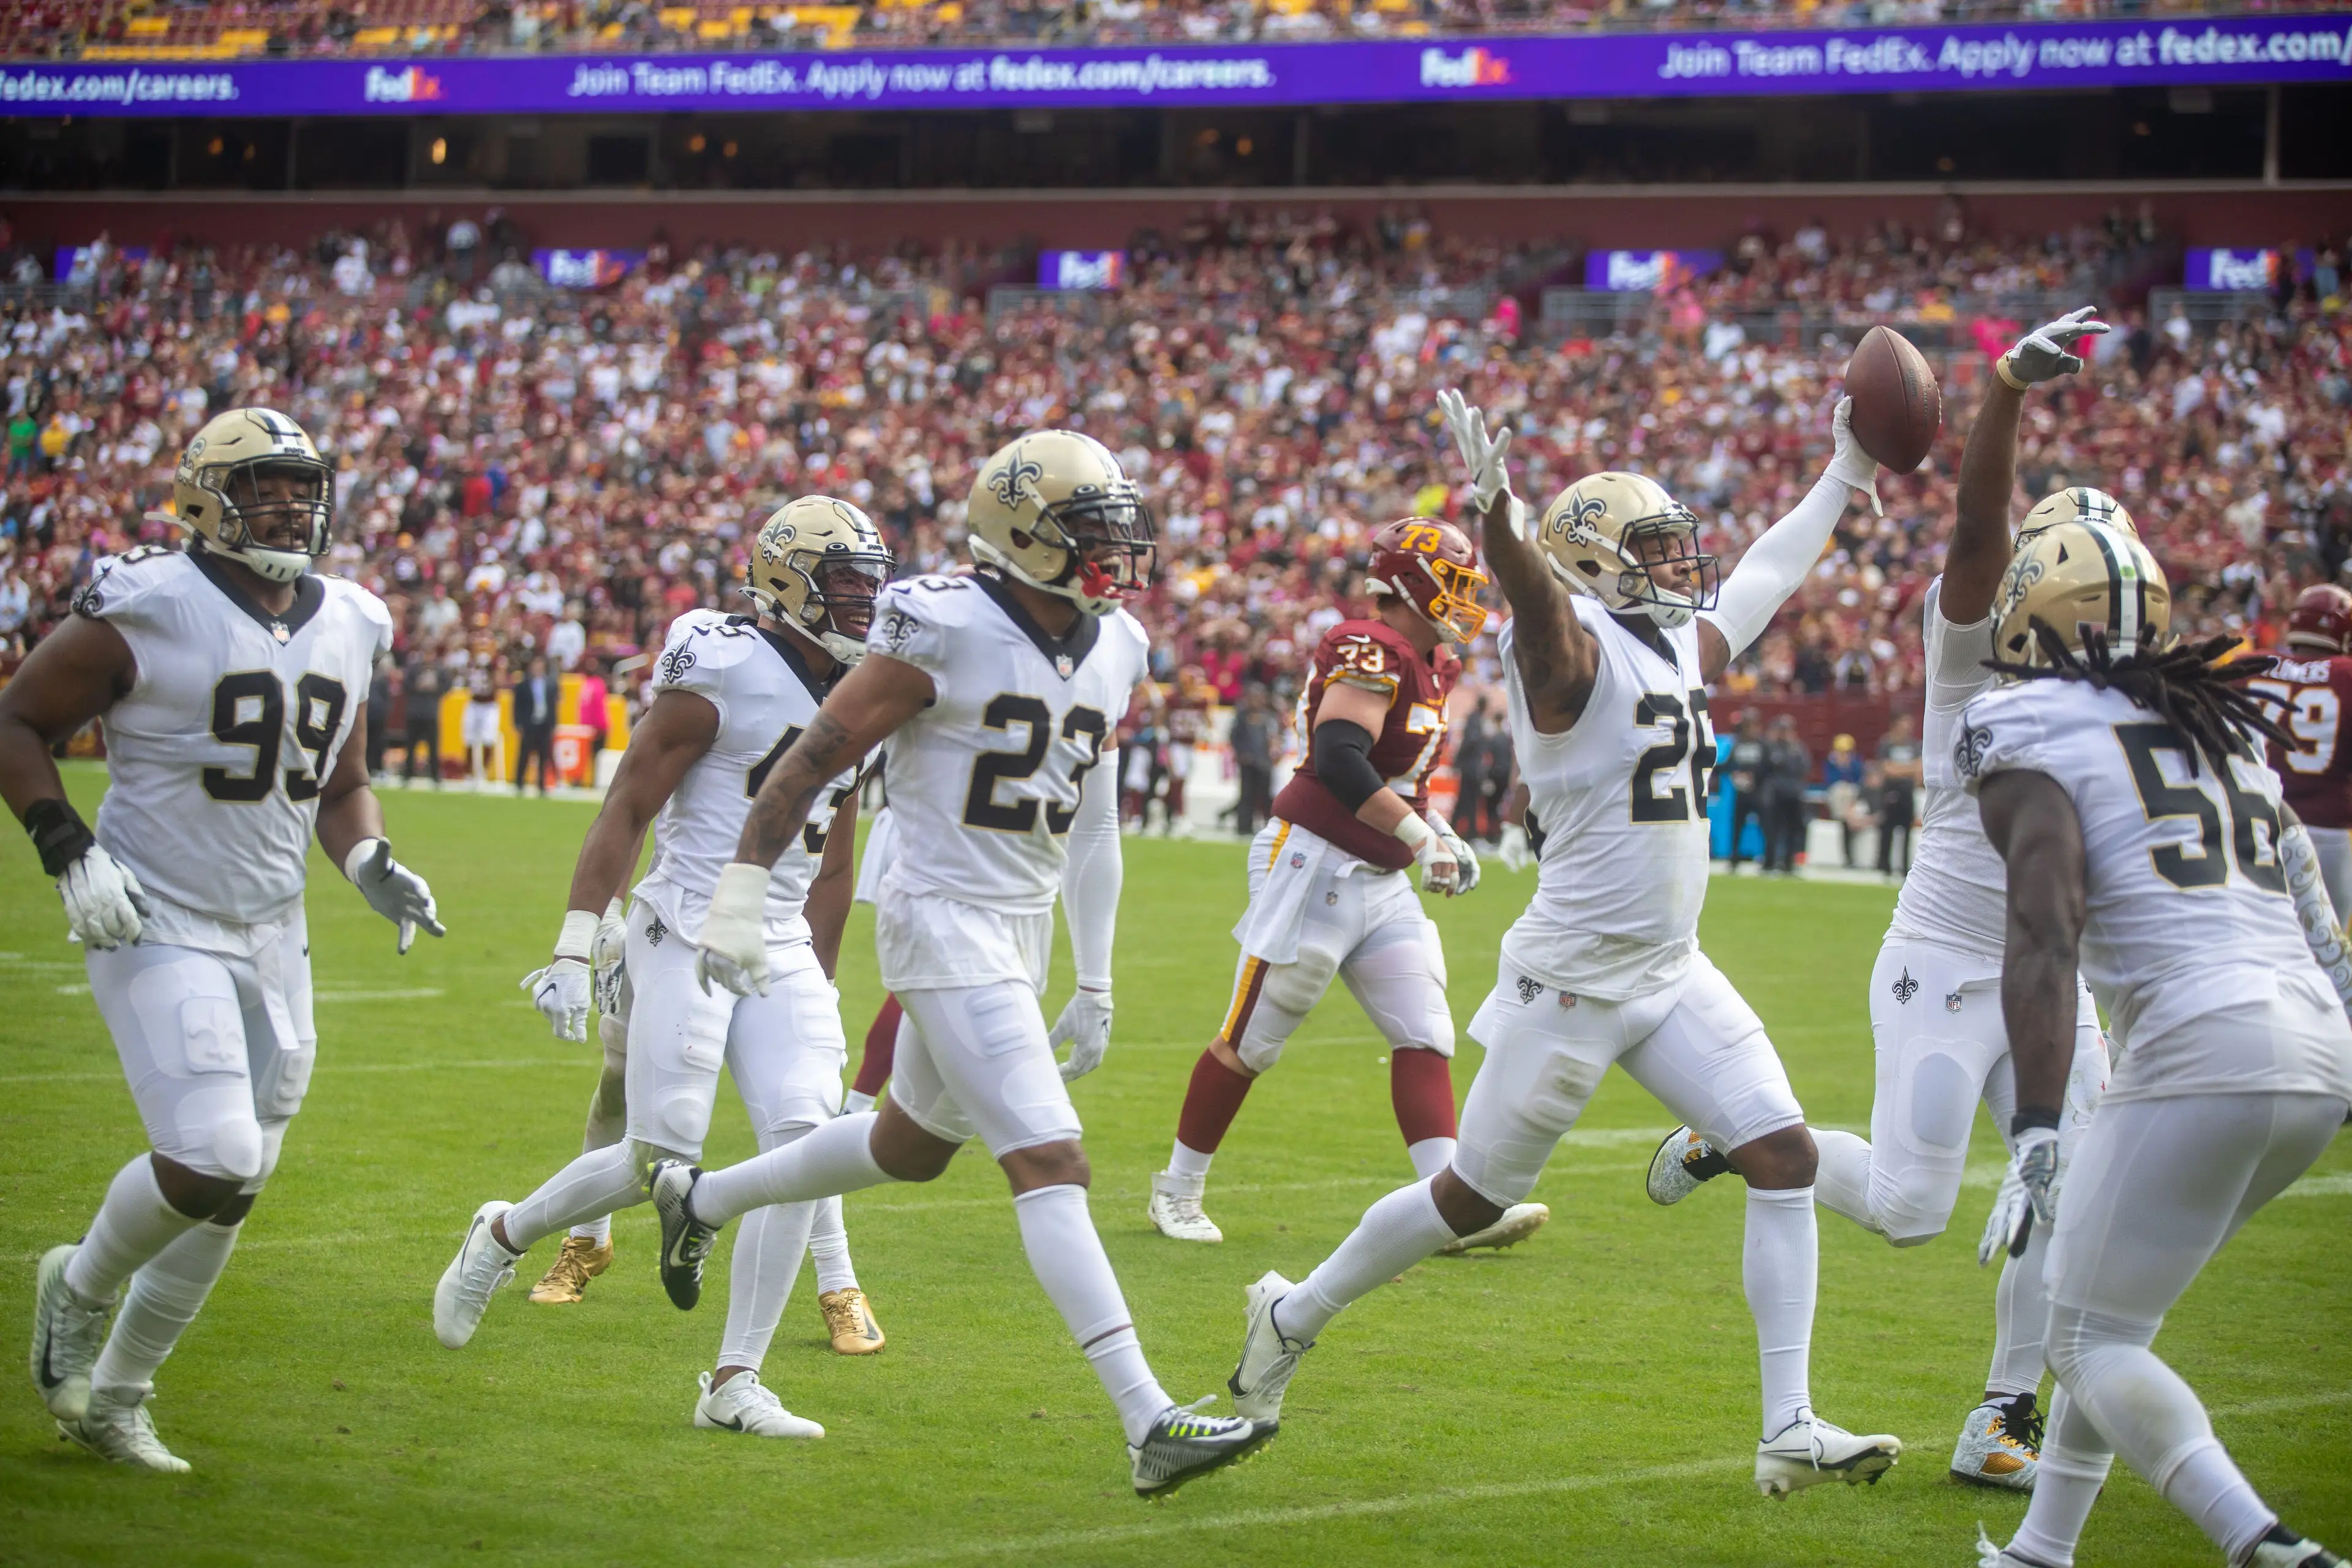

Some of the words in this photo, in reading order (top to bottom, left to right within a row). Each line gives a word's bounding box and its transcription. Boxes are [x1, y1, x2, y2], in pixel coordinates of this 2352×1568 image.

[1420, 47, 1511, 87] FedEx
[1657, 40, 1731, 78] Join
[1732, 40, 1822, 76] Team
[1937, 31, 2037, 78] Apply
[2039, 37, 2113, 68] now
[2115, 29, 2155, 66] at
[365, 65, 441, 103] FedEx
[567, 61, 629, 96] Join
[630, 62, 707, 96] Team
[805, 58, 888, 100] Apply
[889, 63, 952, 91] now
[953, 58, 987, 91] at
[1400, 526, 1442, 552] 73
[1336, 644, 1385, 673] 73
[201, 669, 348, 804] 99
[962, 692, 1107, 837] 23
[2110, 720, 2290, 895] 56
[1948, 1001, 1960, 1009] NFL
